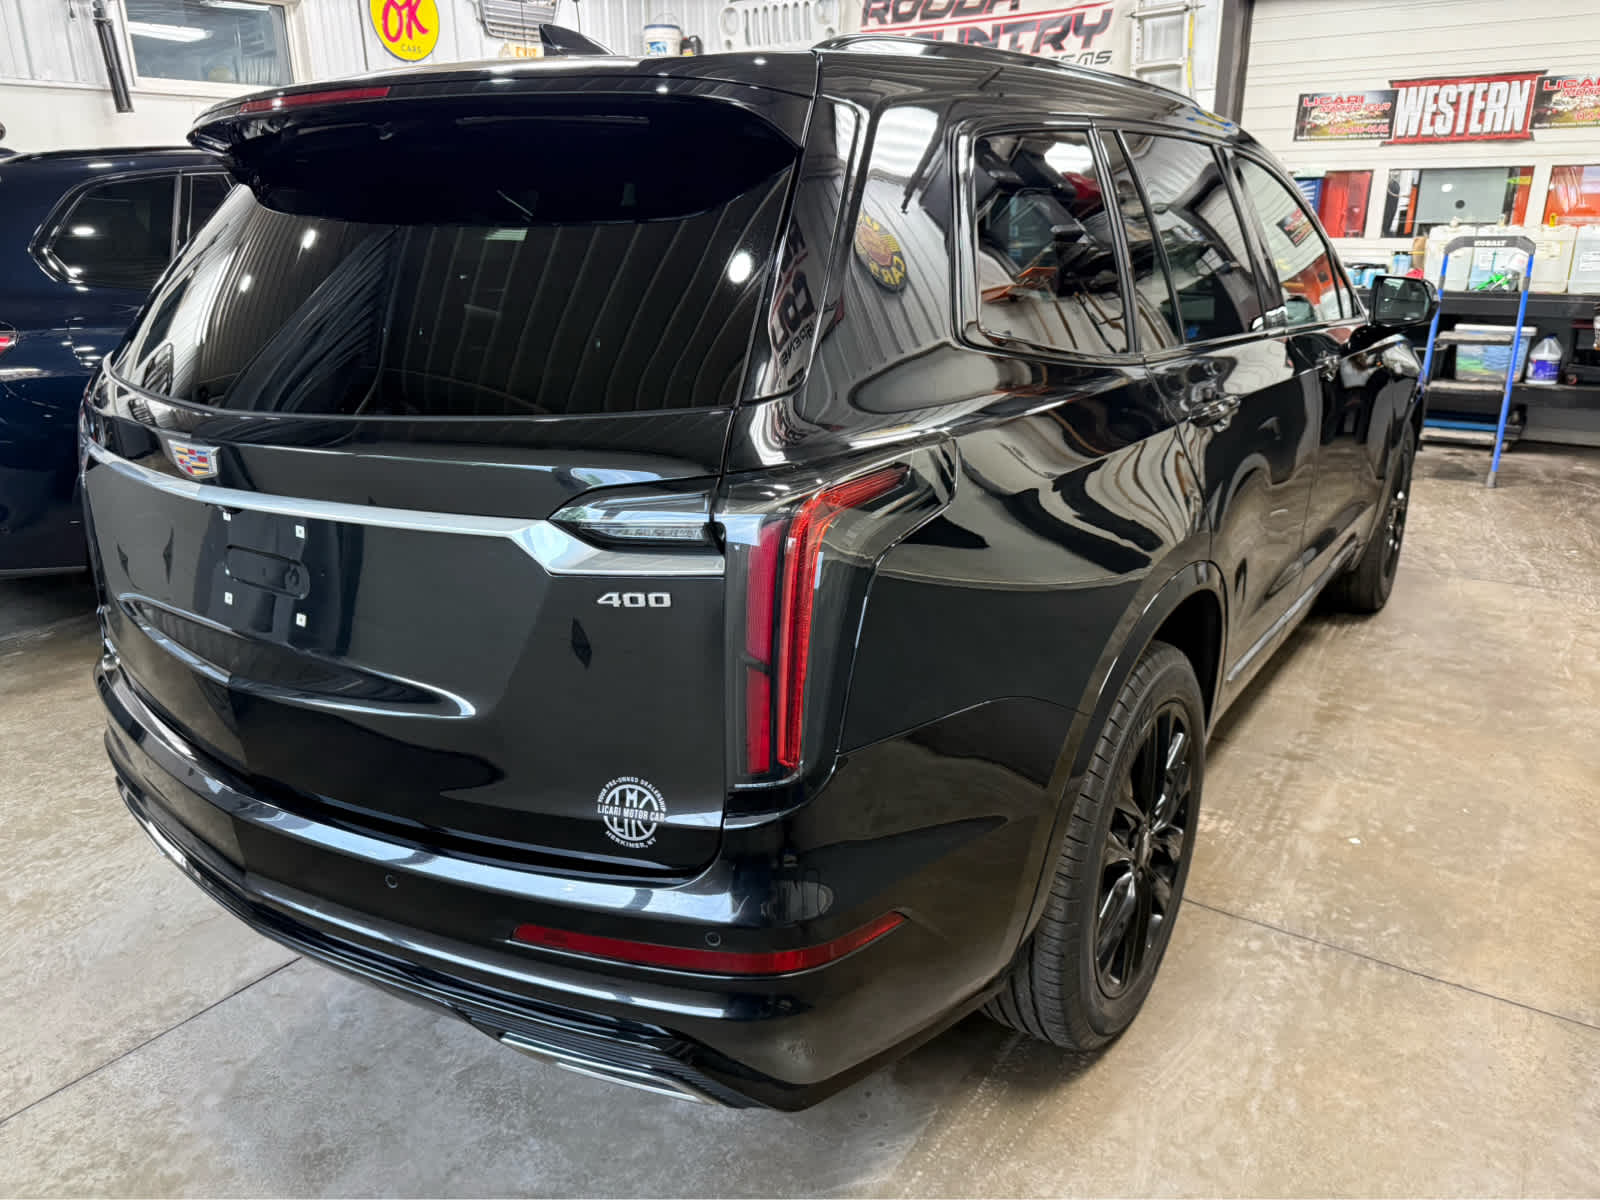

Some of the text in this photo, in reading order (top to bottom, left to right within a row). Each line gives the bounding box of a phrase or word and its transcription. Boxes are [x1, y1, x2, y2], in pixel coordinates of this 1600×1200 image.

[383, 0, 429, 42] OK
[1303, 95, 1364, 107] LICARI
[1396, 80, 1531, 137] WESTERN
[597, 592, 671, 607] 400
[597, 804, 665, 823] LICARI MOTOR CAR
